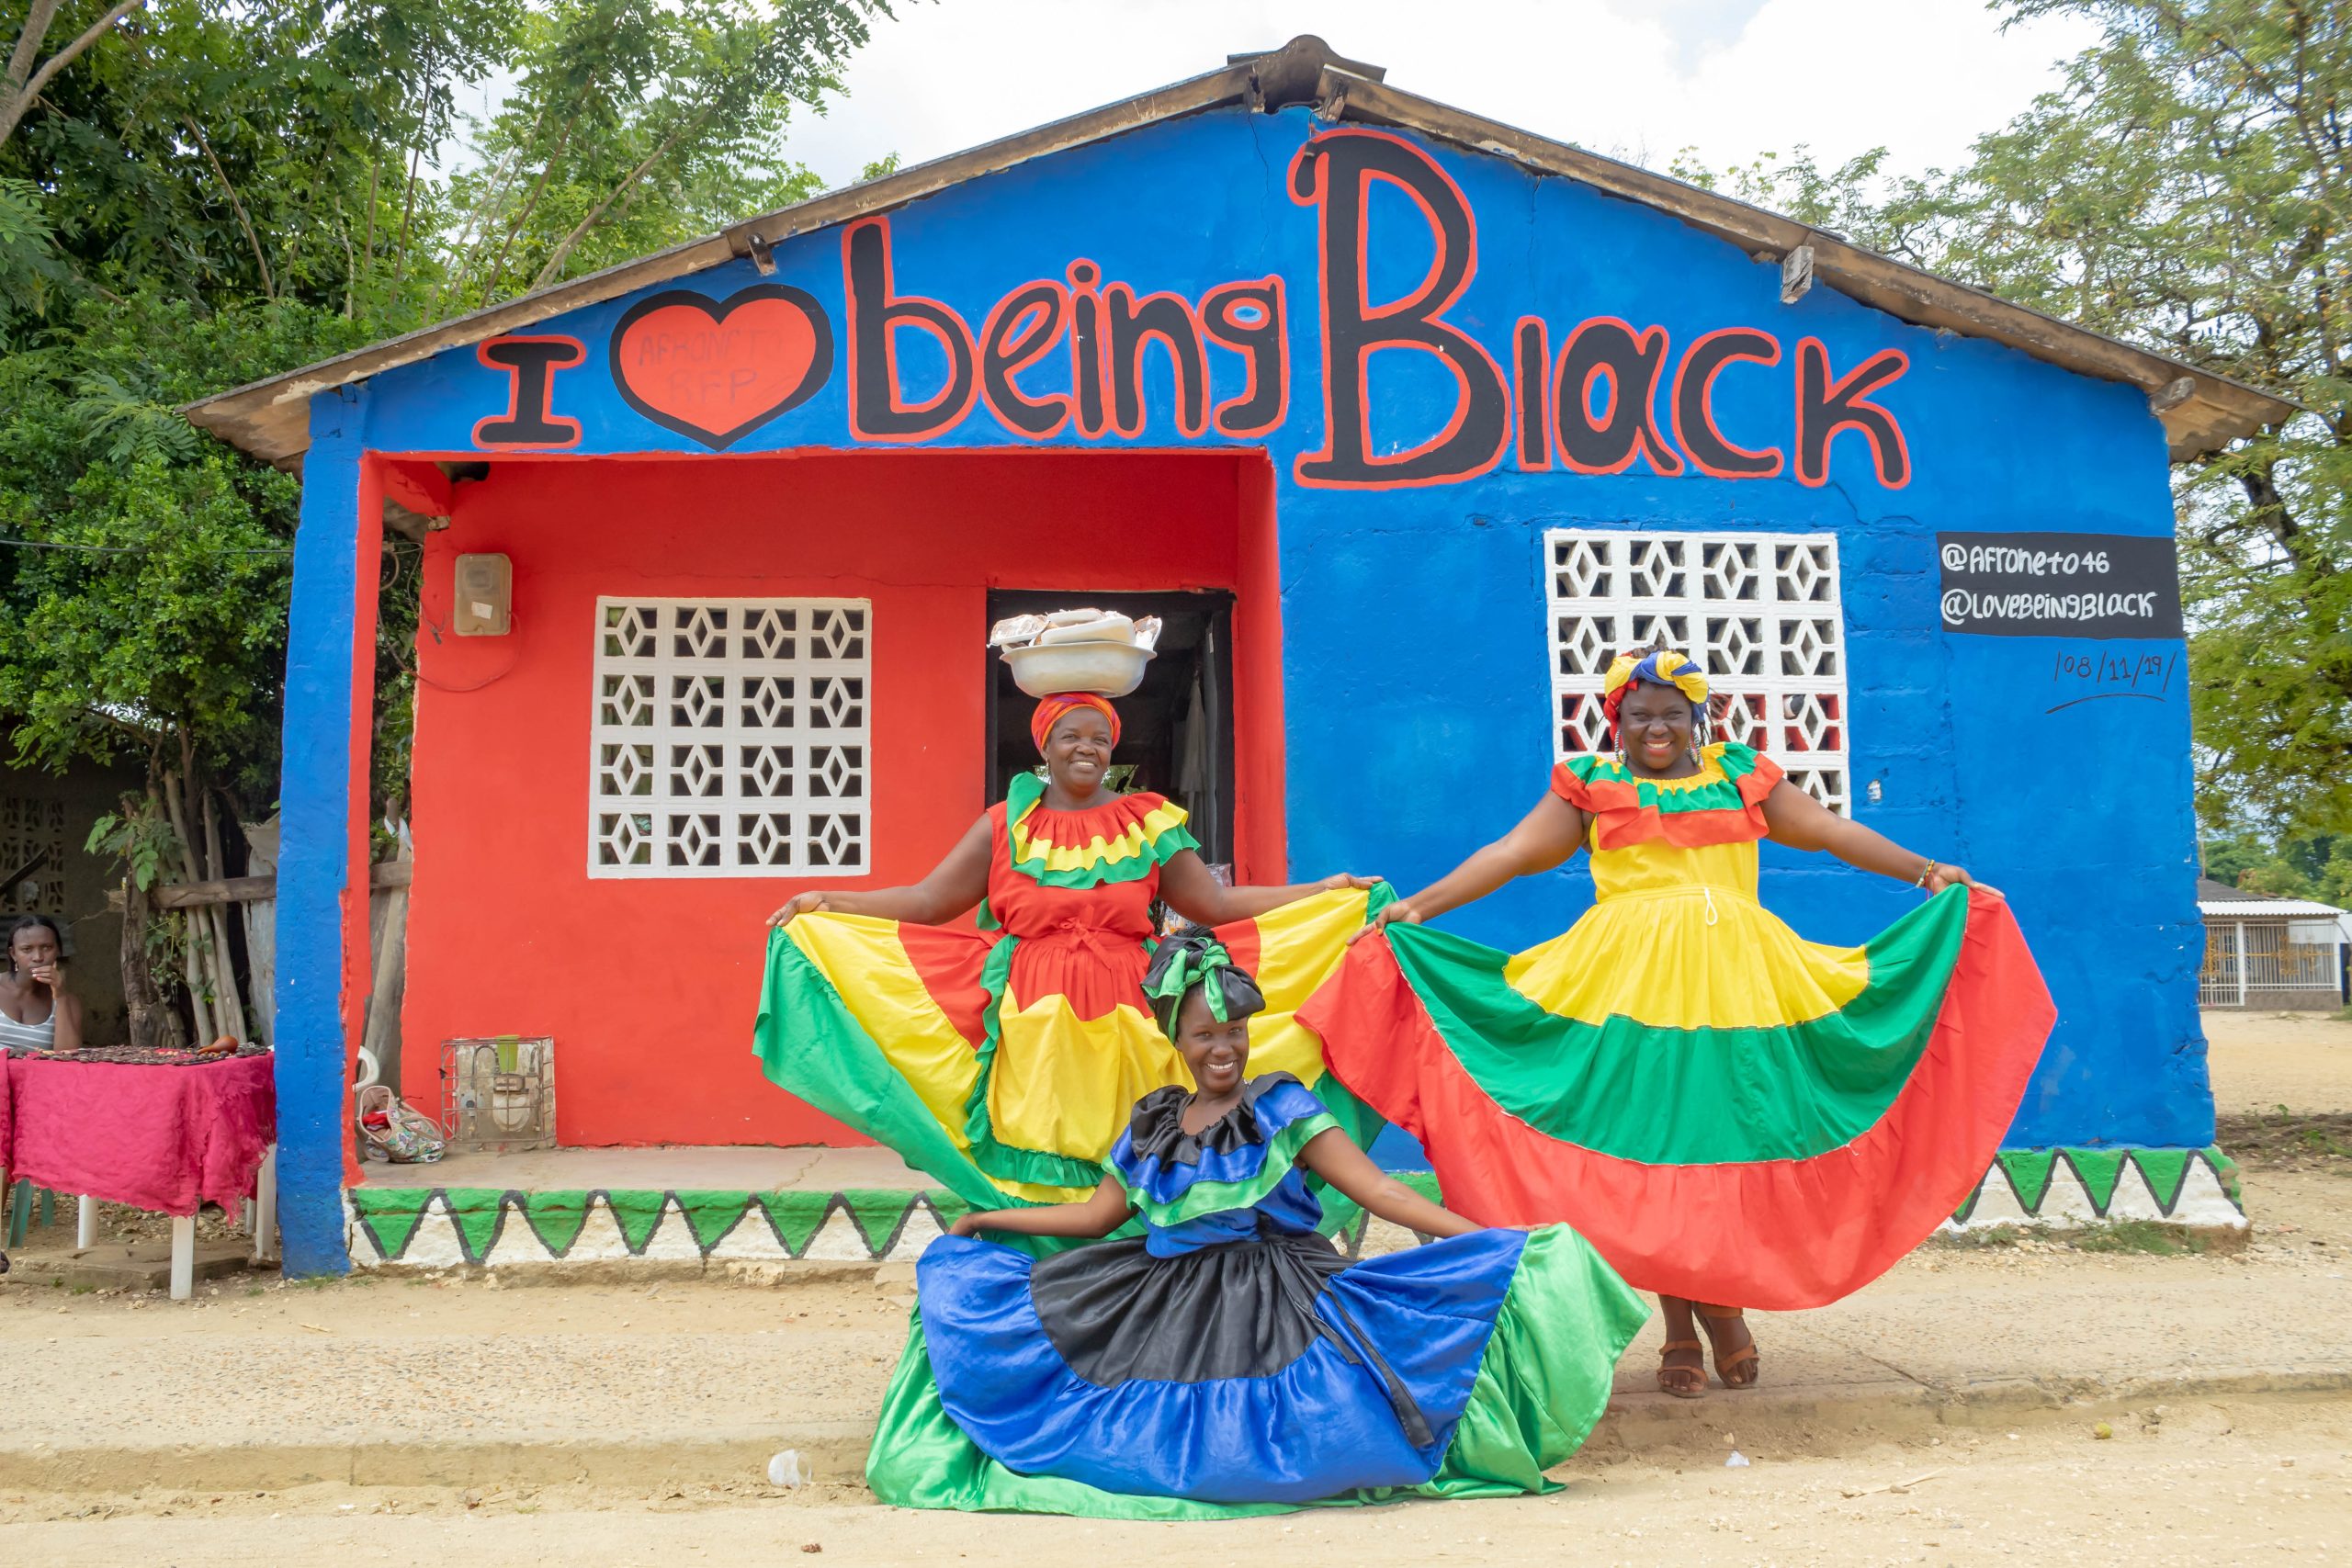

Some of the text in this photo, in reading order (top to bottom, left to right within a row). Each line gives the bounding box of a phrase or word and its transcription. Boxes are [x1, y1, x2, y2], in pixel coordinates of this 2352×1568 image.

[474, 128, 1911, 490] I being Black
